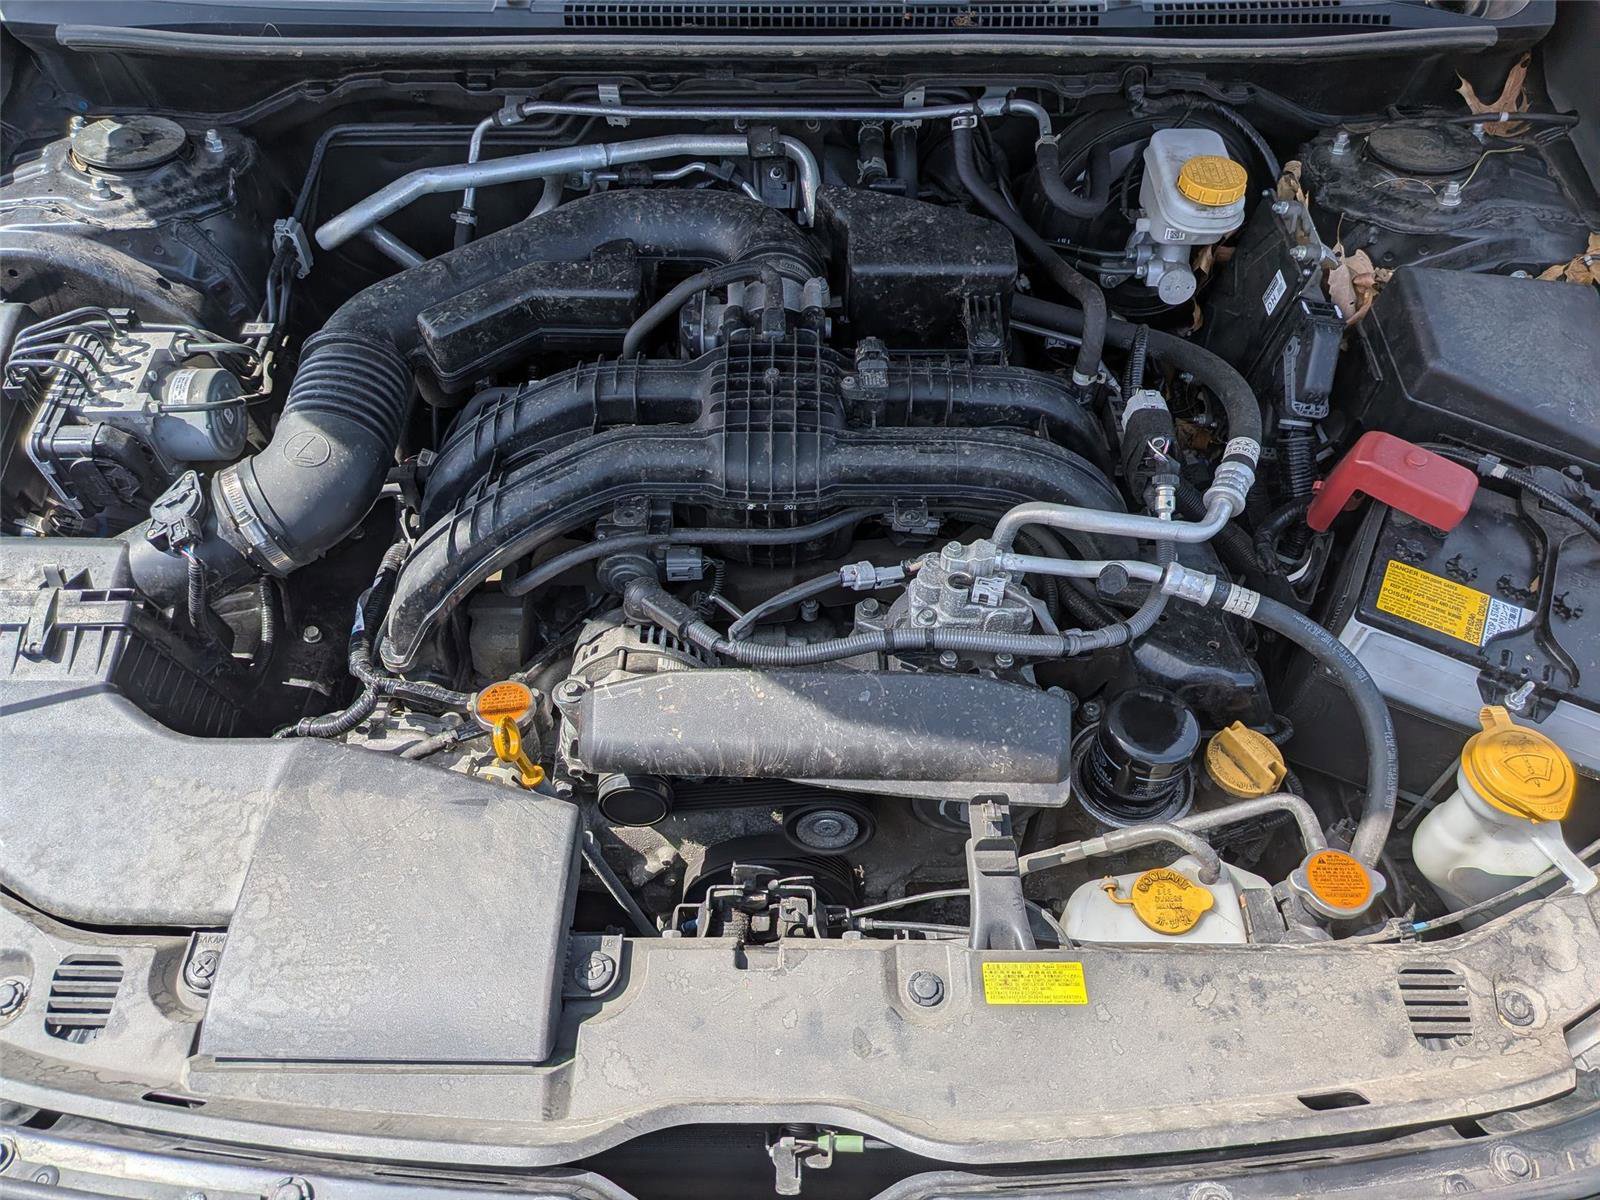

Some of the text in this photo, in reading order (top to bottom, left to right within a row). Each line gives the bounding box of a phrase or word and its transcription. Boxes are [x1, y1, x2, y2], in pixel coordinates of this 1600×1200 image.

[1389, 562, 1418, 576] DANGER
[1382, 587, 1411, 601] POISON
[1137, 870, 1193, 892] COOLANT
